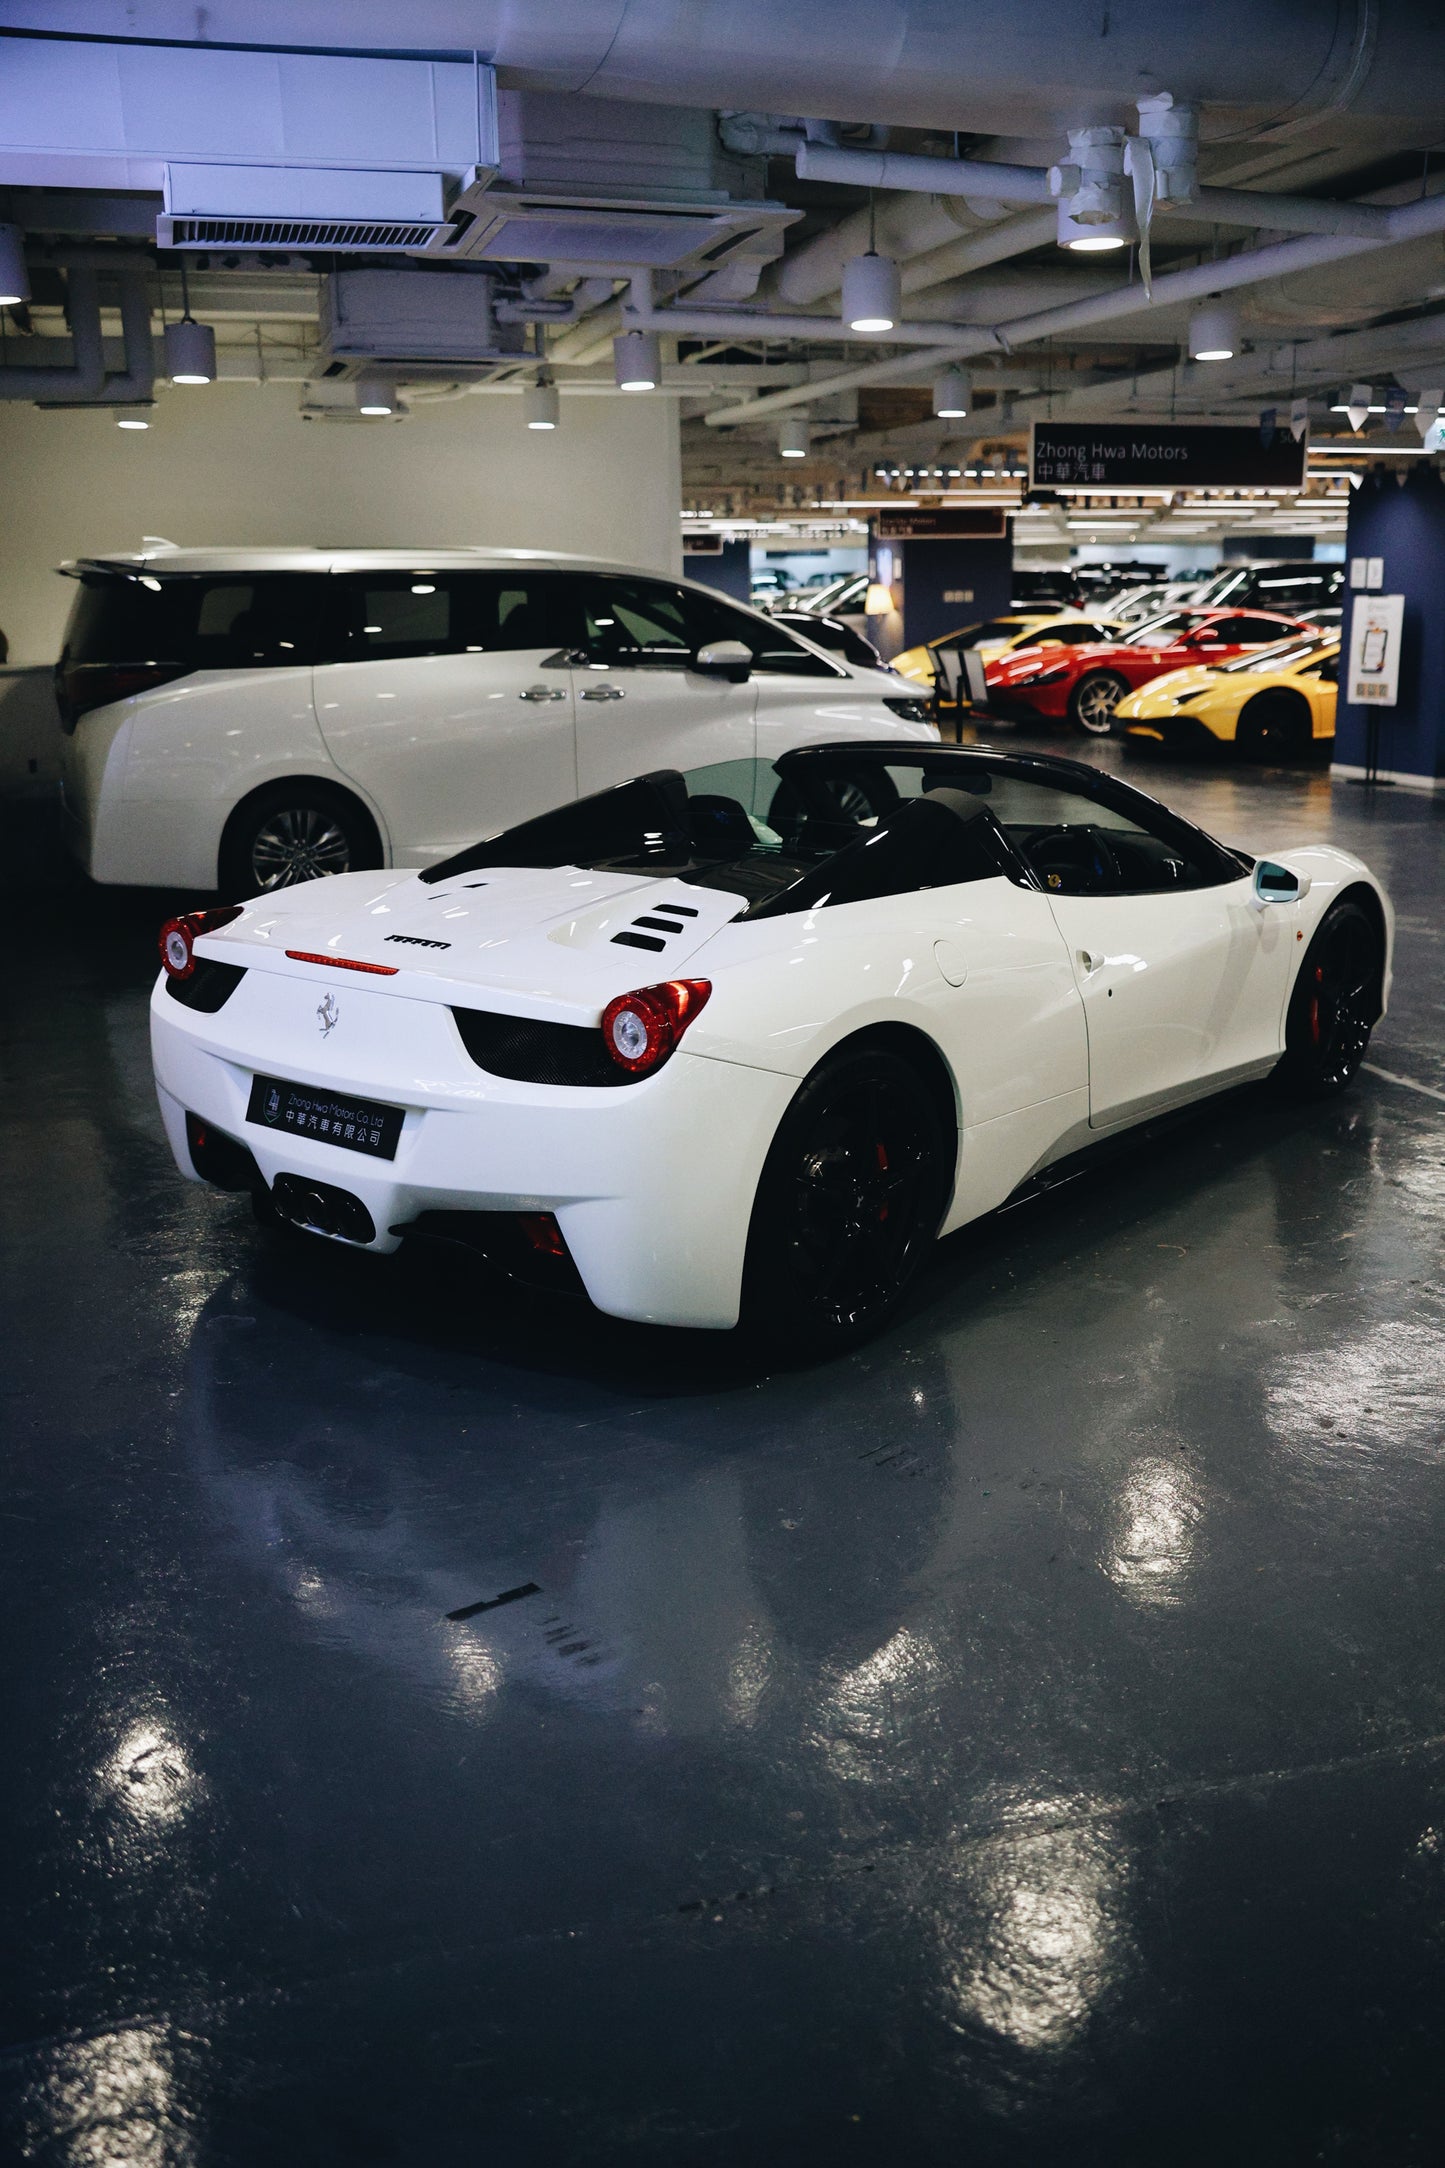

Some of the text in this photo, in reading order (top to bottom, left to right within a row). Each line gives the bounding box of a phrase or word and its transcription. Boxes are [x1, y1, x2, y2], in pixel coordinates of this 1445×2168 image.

[1036, 442, 1189, 462] Zhong Hwa Motors
[1037, 461, 1107, 481] 中華汽車
[288, 1093, 311, 1110] Zhong
[312, 1098, 328, 1113] Hwa
[329, 1103, 355, 1120] Motors
[285, 1109, 381, 1146] 中華汽車有限公司
